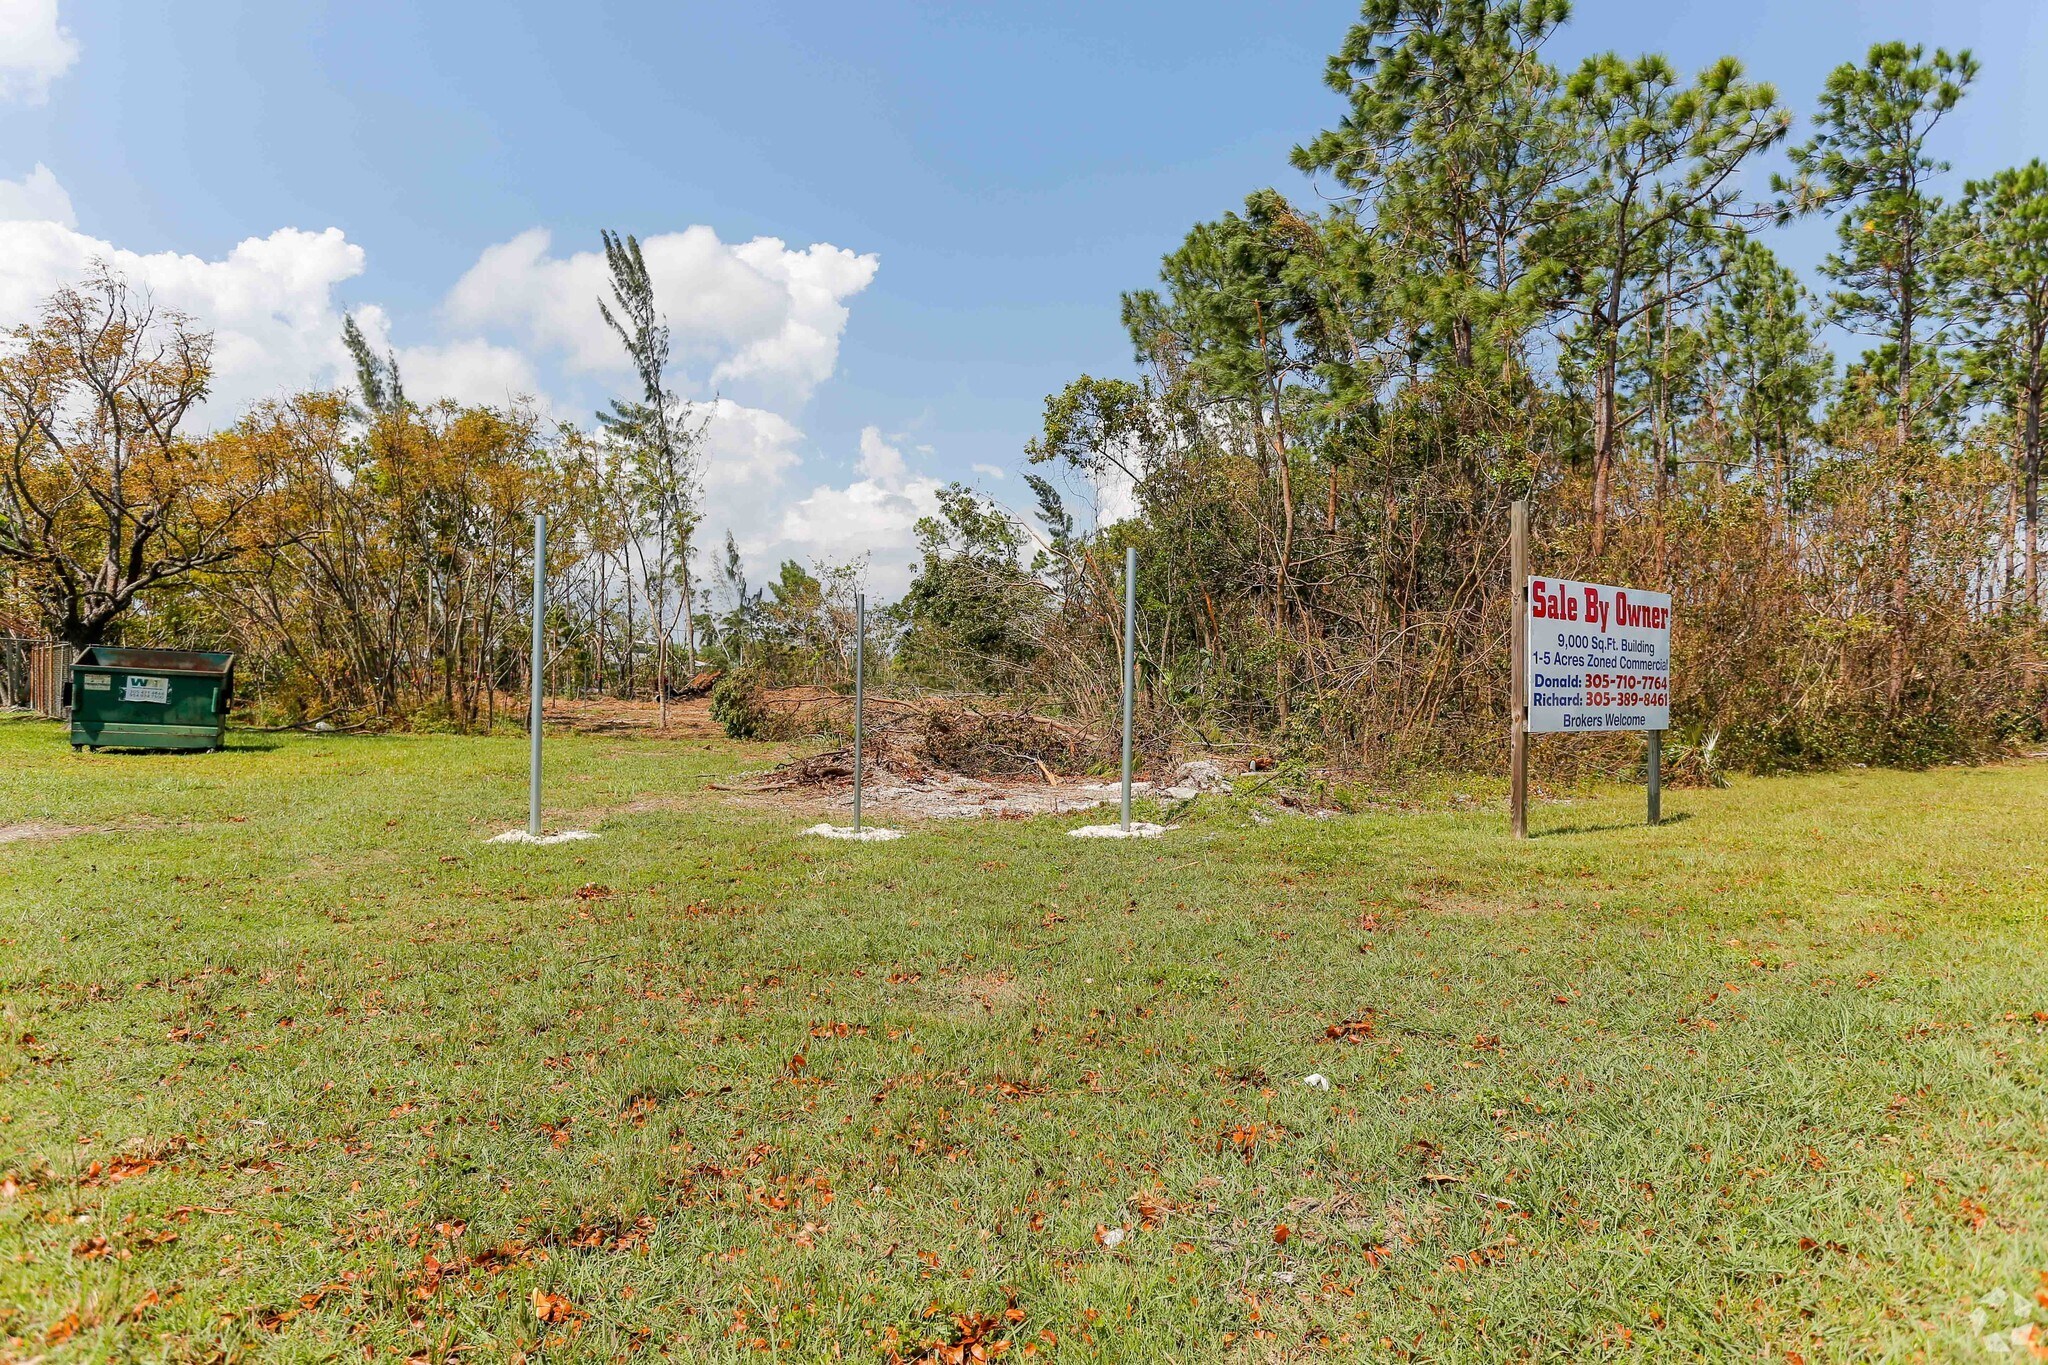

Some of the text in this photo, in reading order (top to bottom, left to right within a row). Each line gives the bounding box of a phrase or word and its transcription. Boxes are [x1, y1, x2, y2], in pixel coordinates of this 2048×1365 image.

[1533, 581, 1668, 633] Sale By Owner
[1557, 634, 1655, 656] 9,000 Sq.Ft. Building
[1533, 651, 1668, 671] 1-5 Acres Zoned Commercial
[1534, 673, 1668, 690] Donald: 305-710-7764
[1533, 691, 1668, 707] Richard: 305-389-8461
[1563, 713, 1646, 727] Brokers Welcome
